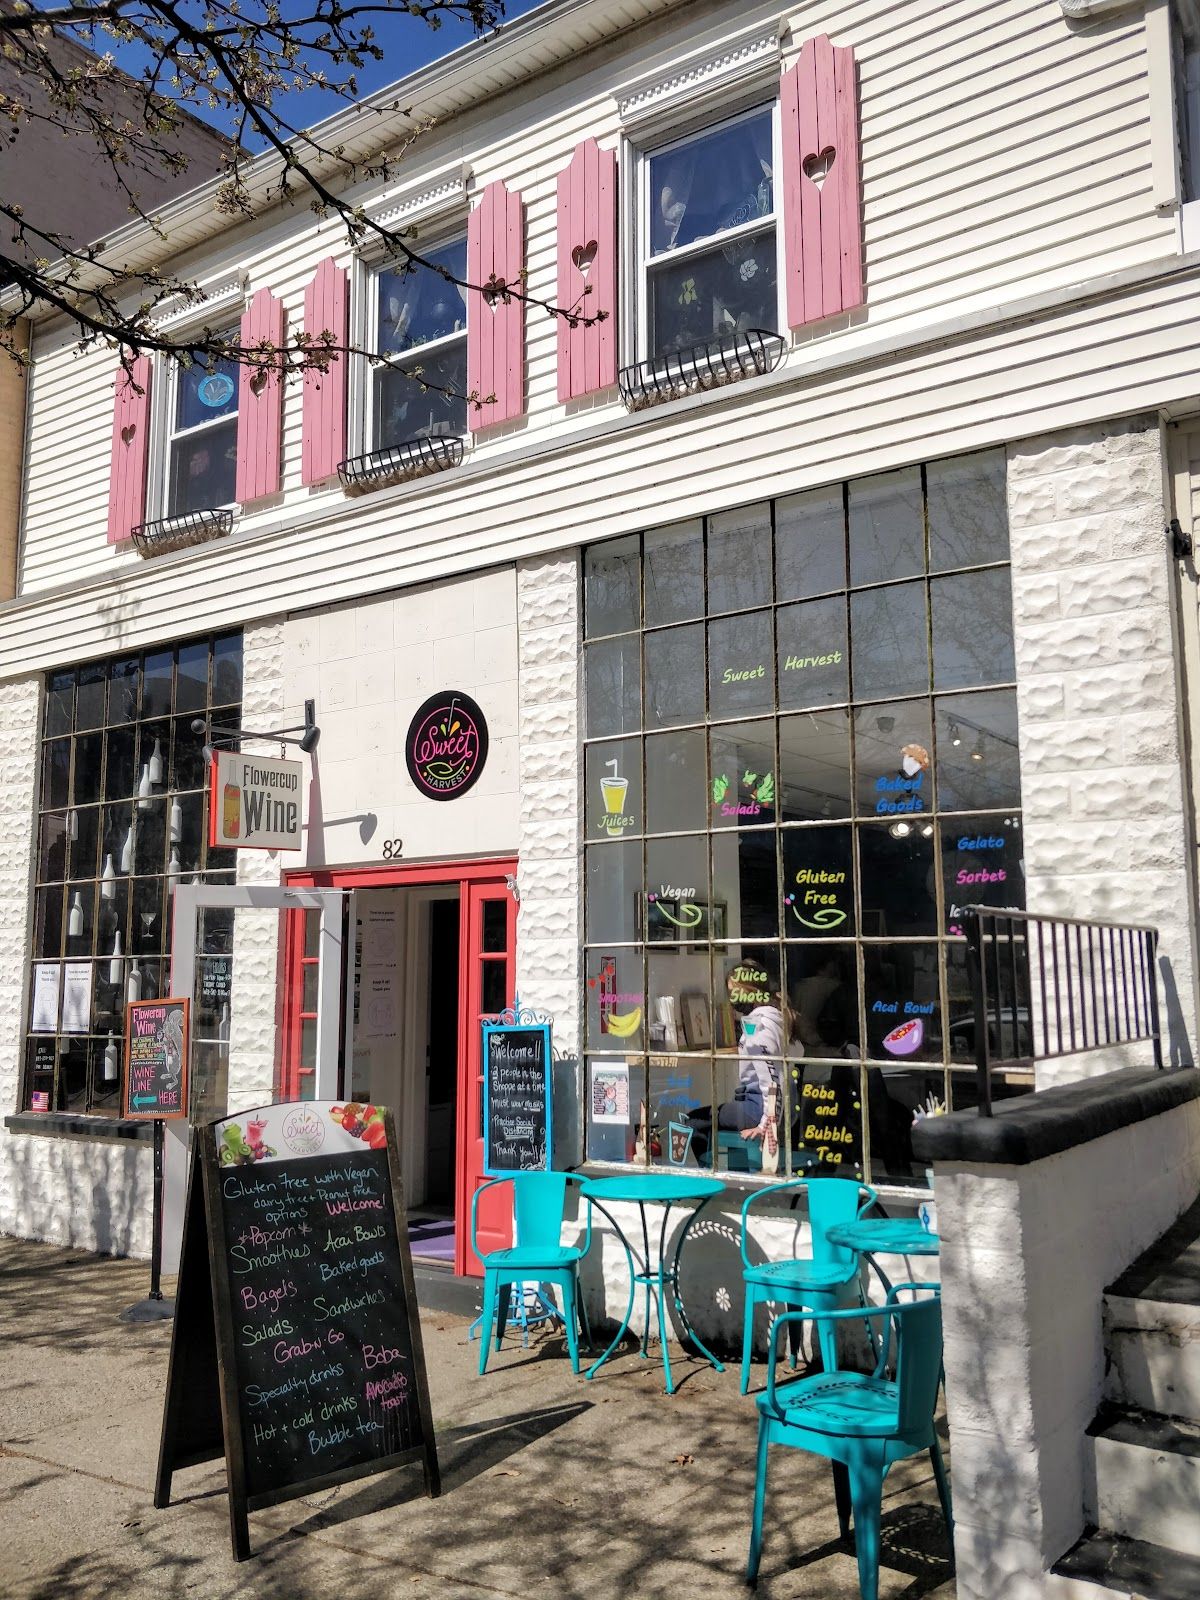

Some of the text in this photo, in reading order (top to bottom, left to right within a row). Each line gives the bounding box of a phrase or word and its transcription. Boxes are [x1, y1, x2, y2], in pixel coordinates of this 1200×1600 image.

[721, 650, 843, 684] Sweet Harvest
[416, 725, 476, 766] Sweet
[243, 764, 298, 792] Flowercup
[425, 769, 467, 789] HARVEST
[720, 802, 761, 817] Salads
[876, 794, 924, 813] Goods
[243, 789, 298, 838] Wine
[597, 814, 635, 828] Juices
[382, 838, 403, 860] 82
[957, 836, 1005, 850] Gelato
[795, 869, 846, 885] Gluten
[956, 868, 1007, 885] Sorbet
[660, 884, 696, 900] Vegan
[804, 890, 837, 905] Free
[730, 967, 768, 982] Juice
[729, 988, 771, 1004] Shots
[872, 1000, 936, 1015] Acai Bowl
[133, 1065, 157, 1079] WINE
[500, 1067, 521, 1081] people
[529, 1066, 543, 1080] the
[158, 1090, 178, 1105] HERE
[492, 1081, 516, 1097] Shoppe
[802, 1083, 836, 1100] Boba
[815, 1102, 839, 1116] and
[282, 1117, 322, 1141] Sweet
[804, 1124, 854, 1144] Bubble
[493, 1141, 517, 1157] Thank
[816, 1146, 842, 1164] Tea
[223, 1166, 379, 1199] Gluten Free with Vegan
[253, 1197, 285, 1213] dairy
[316, 1187, 350, 1201] Peanut
[352, 1185, 377, 1197] free
[326, 1193, 386, 1216] Welcome!
[265, 1207, 309, 1226] options
[323, 1224, 386, 1253] Acai Bowls
[230, 1244, 311, 1274] Smoothies
[319, 1250, 385, 1282] Baked goods
[240, 1279, 298, 1313] Bagels
[242, 1319, 294, 1347] Salads
[362, 1344, 407, 1370] Boba
[244, 1376, 308, 1408] Specialty
[253, 1422, 277, 1446] Hot
[292, 1409, 314, 1430] cold
[320, 1394, 358, 1421] drinks
[308, 1415, 384, 1456] Bubble tea
